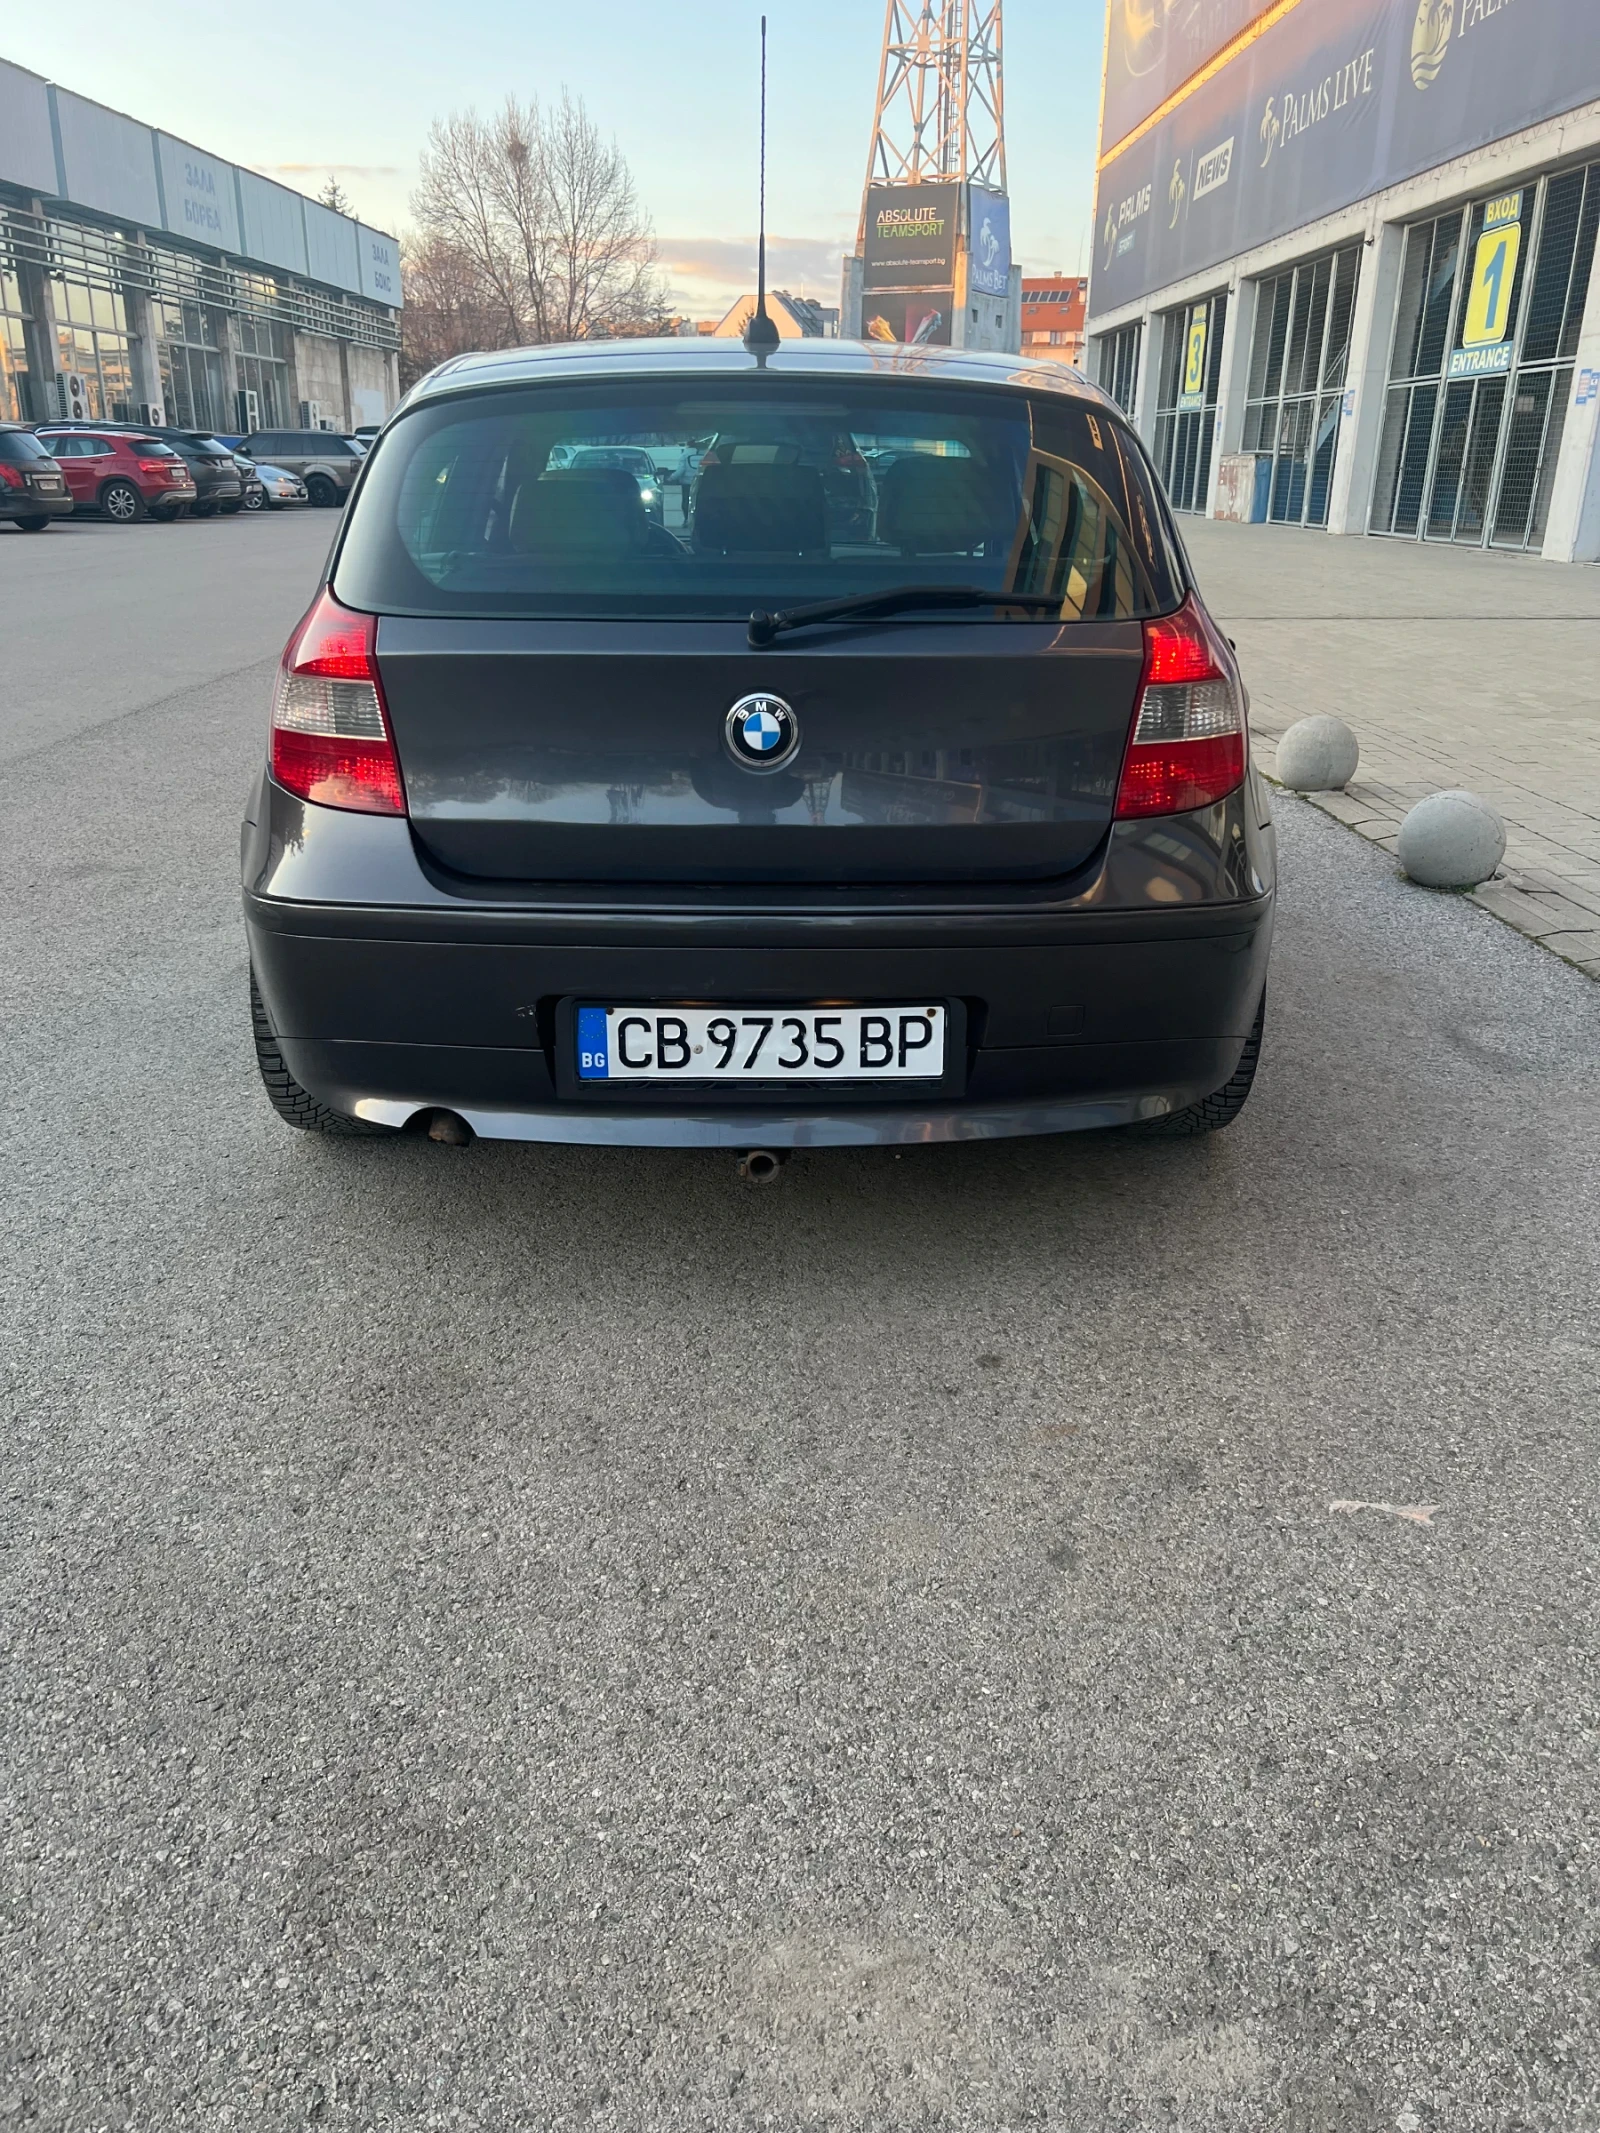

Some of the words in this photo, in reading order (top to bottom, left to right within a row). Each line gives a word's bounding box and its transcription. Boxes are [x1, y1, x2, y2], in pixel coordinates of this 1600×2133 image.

[1280, 76, 1331, 148] PALMS
[1333, 48, 1375, 111] LIVE
[185, 163, 216, 196] ЗАЛА
[1197, 147, 1230, 191] NEWS
[876, 207, 937, 223] ABSOLUTE
[1118, 183, 1152, 229] PALMS
[1486, 194, 1519, 224] ВХОД
[876, 222, 945, 238] TEAMSPORT
[1483, 241, 1507, 330] 1
[1190, 334, 1201, 383] 3
[1450, 346, 1510, 373] ENTRANCE
[737, 701, 787, 722] BMW
[617, 1016, 691, 1068] CB
[706, 1017, 845, 1069] 9735
[859, 1015, 933, 1068] BP
[581, 1053, 605, 1067] BG
